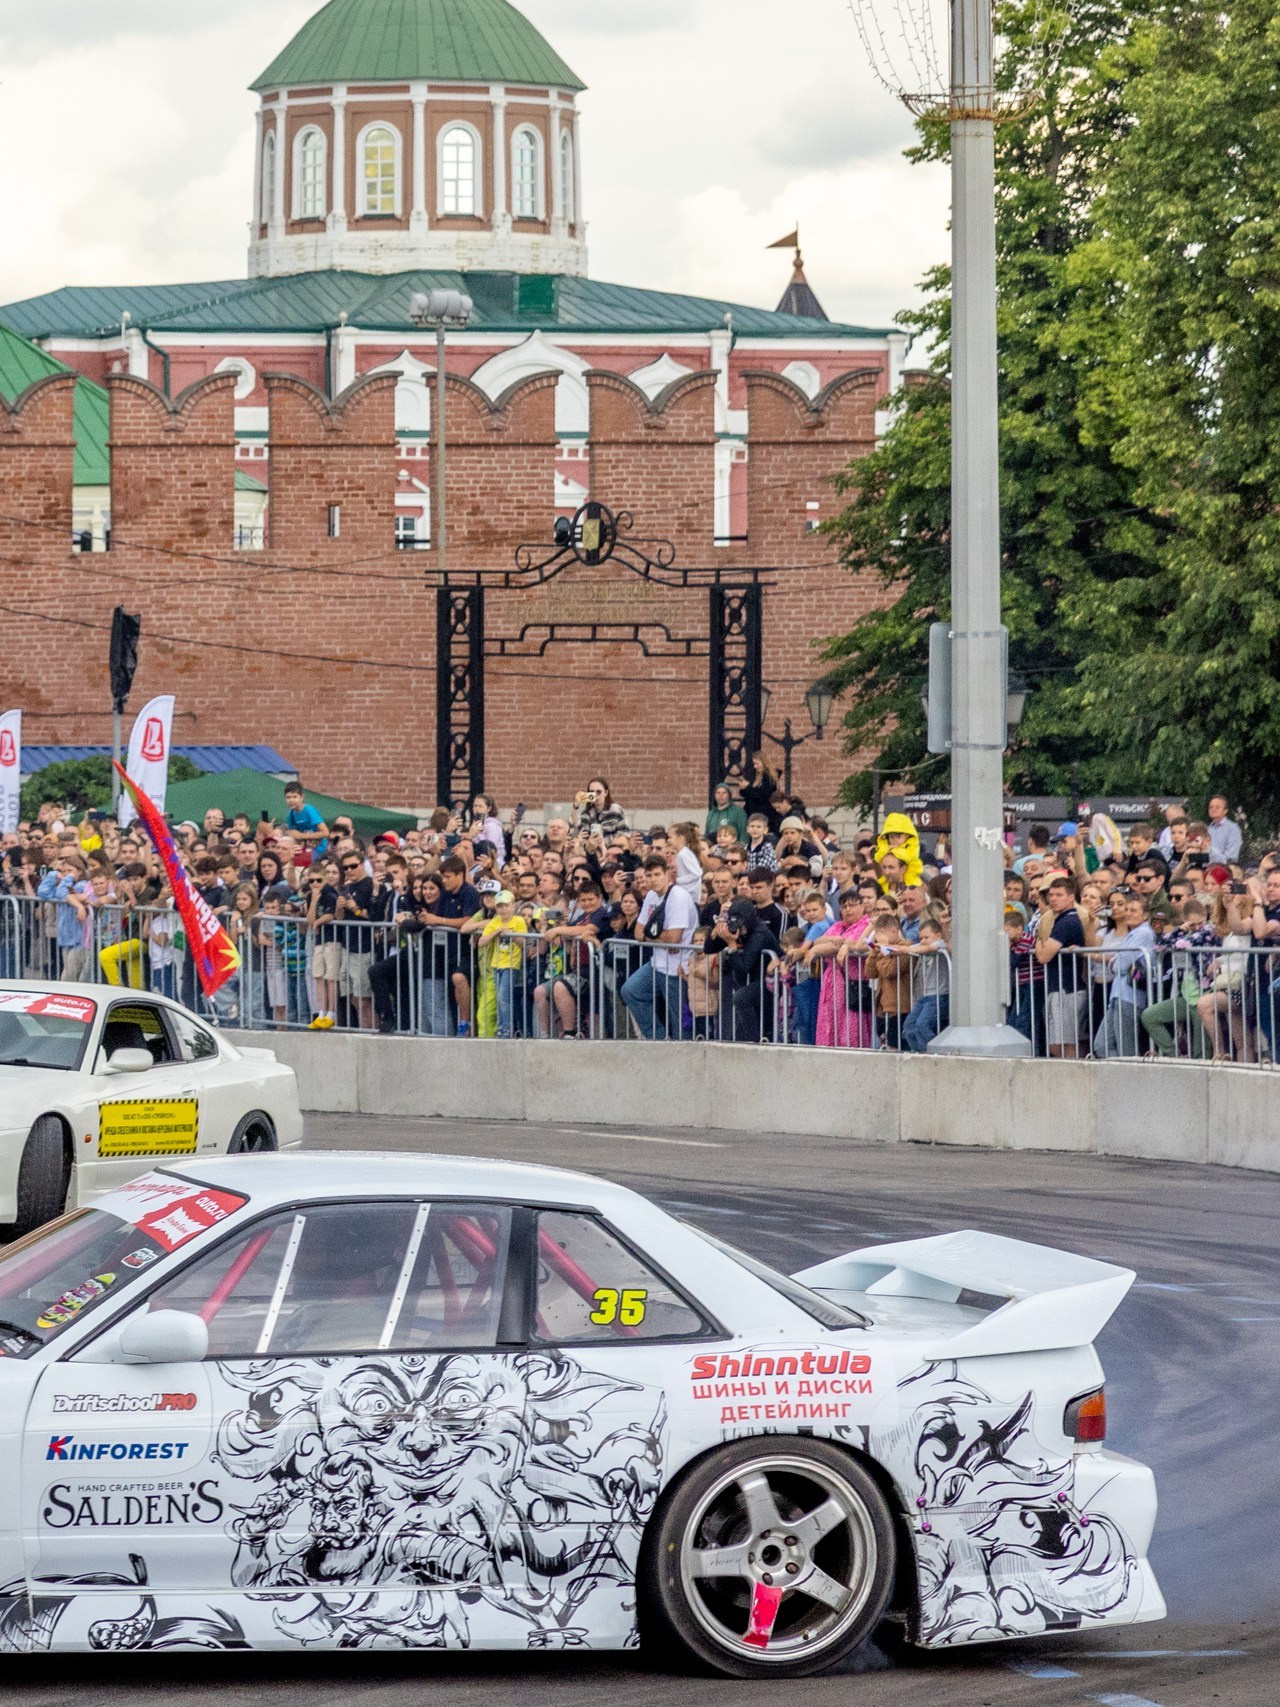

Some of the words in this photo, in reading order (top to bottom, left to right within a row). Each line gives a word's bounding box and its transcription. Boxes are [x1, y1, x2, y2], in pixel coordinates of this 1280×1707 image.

[53, 997, 92, 1008] auto.ru
[195, 1196, 229, 1220] auto.ru
[590, 1288, 648, 1326] 35
[691, 1351, 871, 1380] Shinntula
[692, 1380, 766, 1400] ШИНЫ
[775, 1380, 790, 1397] И
[797, 1377, 874, 1397] ДИСКИ
[721, 1401, 852, 1423] ДЕТЕЙЛИНГ
[46, 1435, 189, 1461] KINFOREST
[77, 1484, 106, 1493] HAND
[109, 1483, 155, 1492] CRAFTED
[157, 1481, 184, 1491] BEER
[43, 1480, 224, 1528] SALDEN'S
